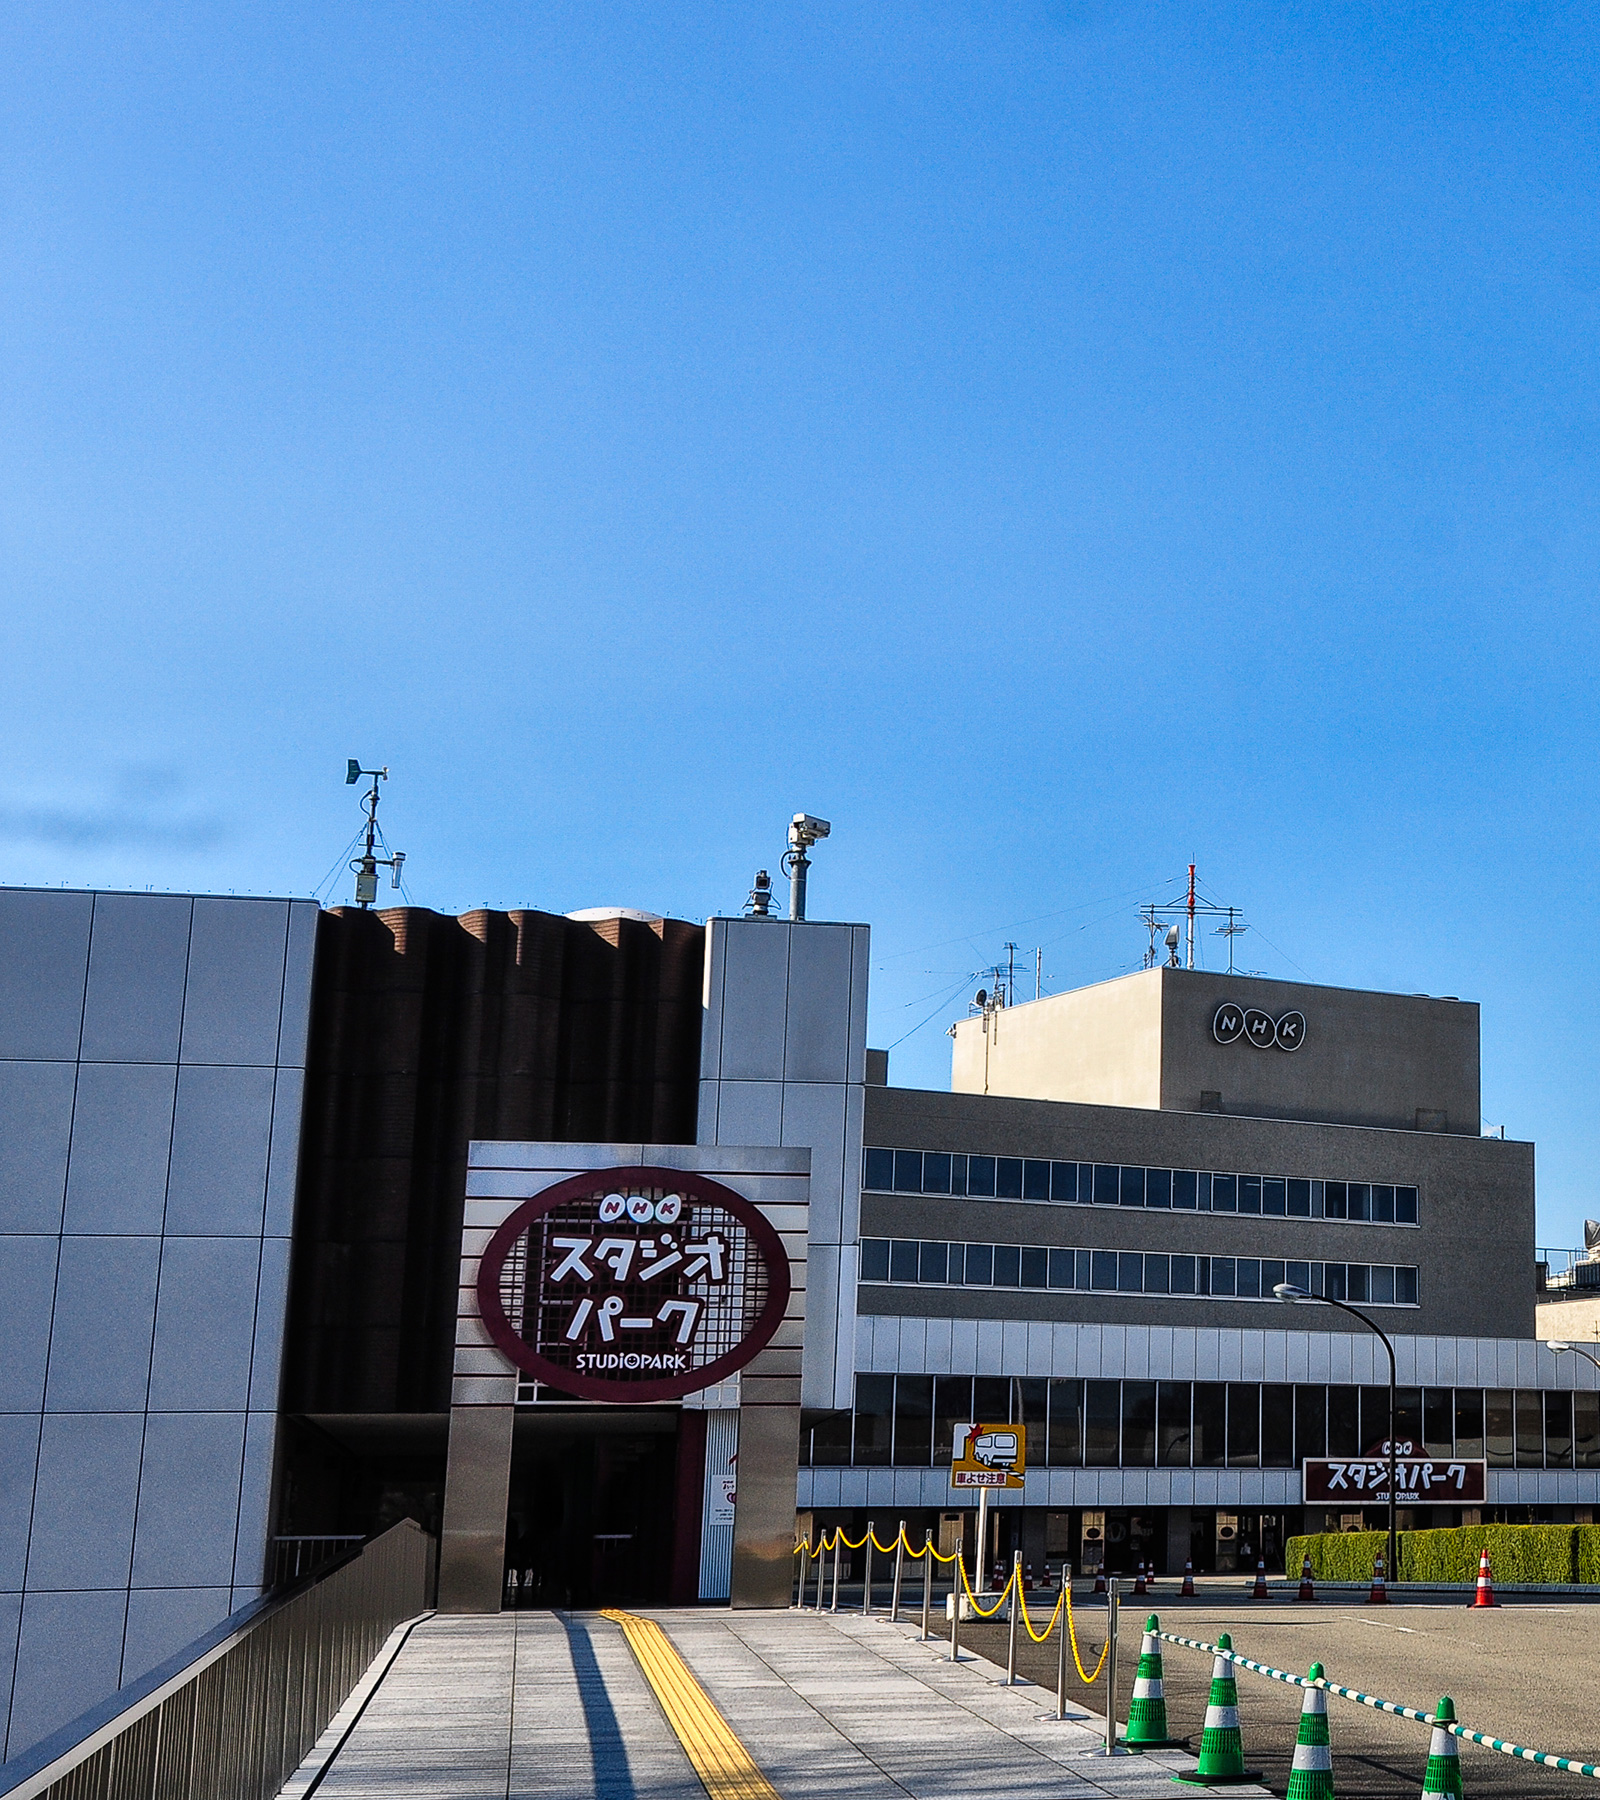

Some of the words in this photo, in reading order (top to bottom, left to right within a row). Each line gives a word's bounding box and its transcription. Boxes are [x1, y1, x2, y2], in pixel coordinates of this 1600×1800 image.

[1218, 1012, 1299, 1040] NHK
[602, 1198, 677, 1217] NHK
[550, 1233, 724, 1282] スタジオ
[565, 1296, 700, 1343] パーク
[956, 1473, 1005, 1484] 車よせ注意
[1328, 1461, 1466, 1489] スタジオパーク
